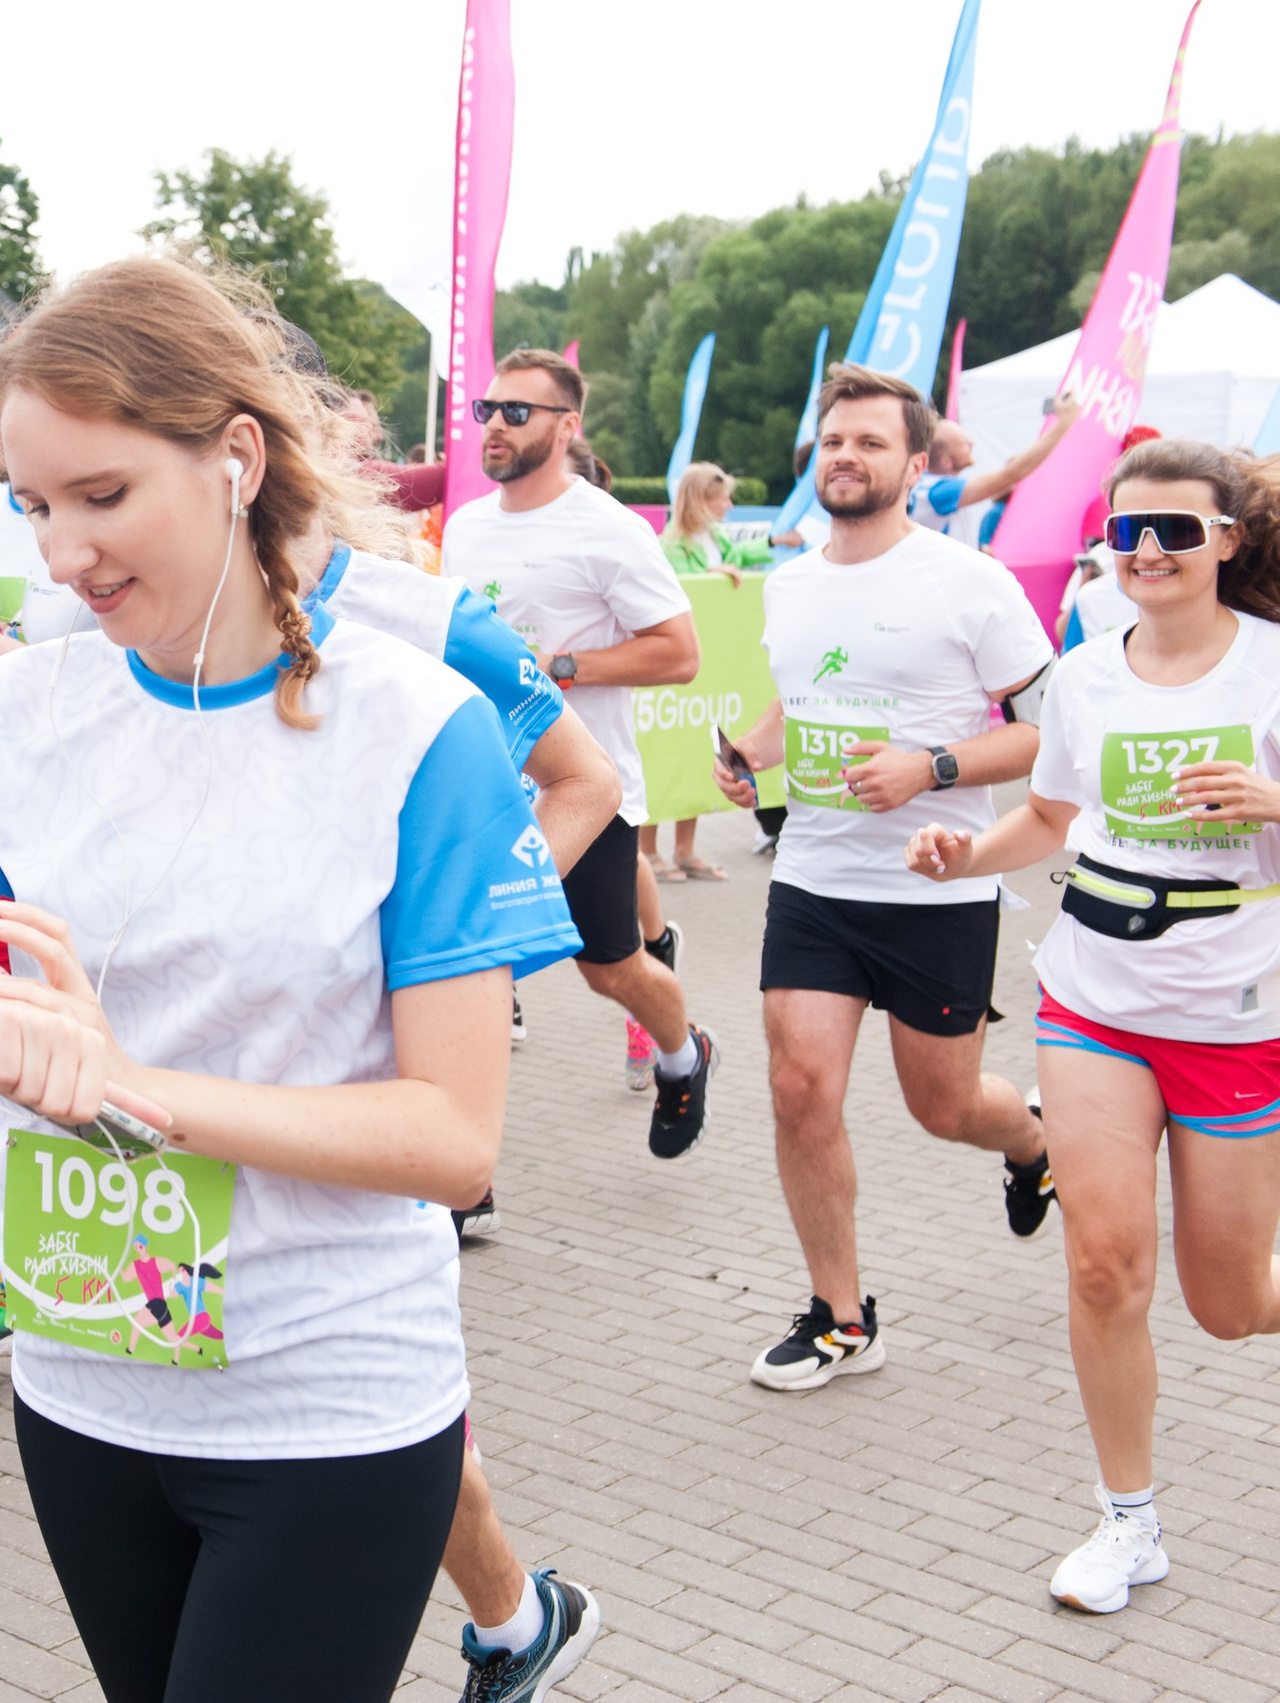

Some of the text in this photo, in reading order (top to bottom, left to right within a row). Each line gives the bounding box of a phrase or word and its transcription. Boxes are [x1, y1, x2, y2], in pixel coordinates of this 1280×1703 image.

[631, 688, 742, 735] 5Group
[798, 725, 861, 759] 1319
[1122, 736, 1220, 775] 1327
[1125, 779, 1153, 795] ЗАБЕГ
[1137, 839, 1158, 850] ЗА
[1167, 838, 1252, 852] БУДУЩЕЕ
[488, 877, 538, 899] ЛИНИЯ
[35, 1150, 186, 1234] 1098
[38, 1230, 81, 1254] ЗАБЕГ
[24, 1255, 56, 1275] РАДИ
[54, 1275, 112, 1306] 5 КМ
